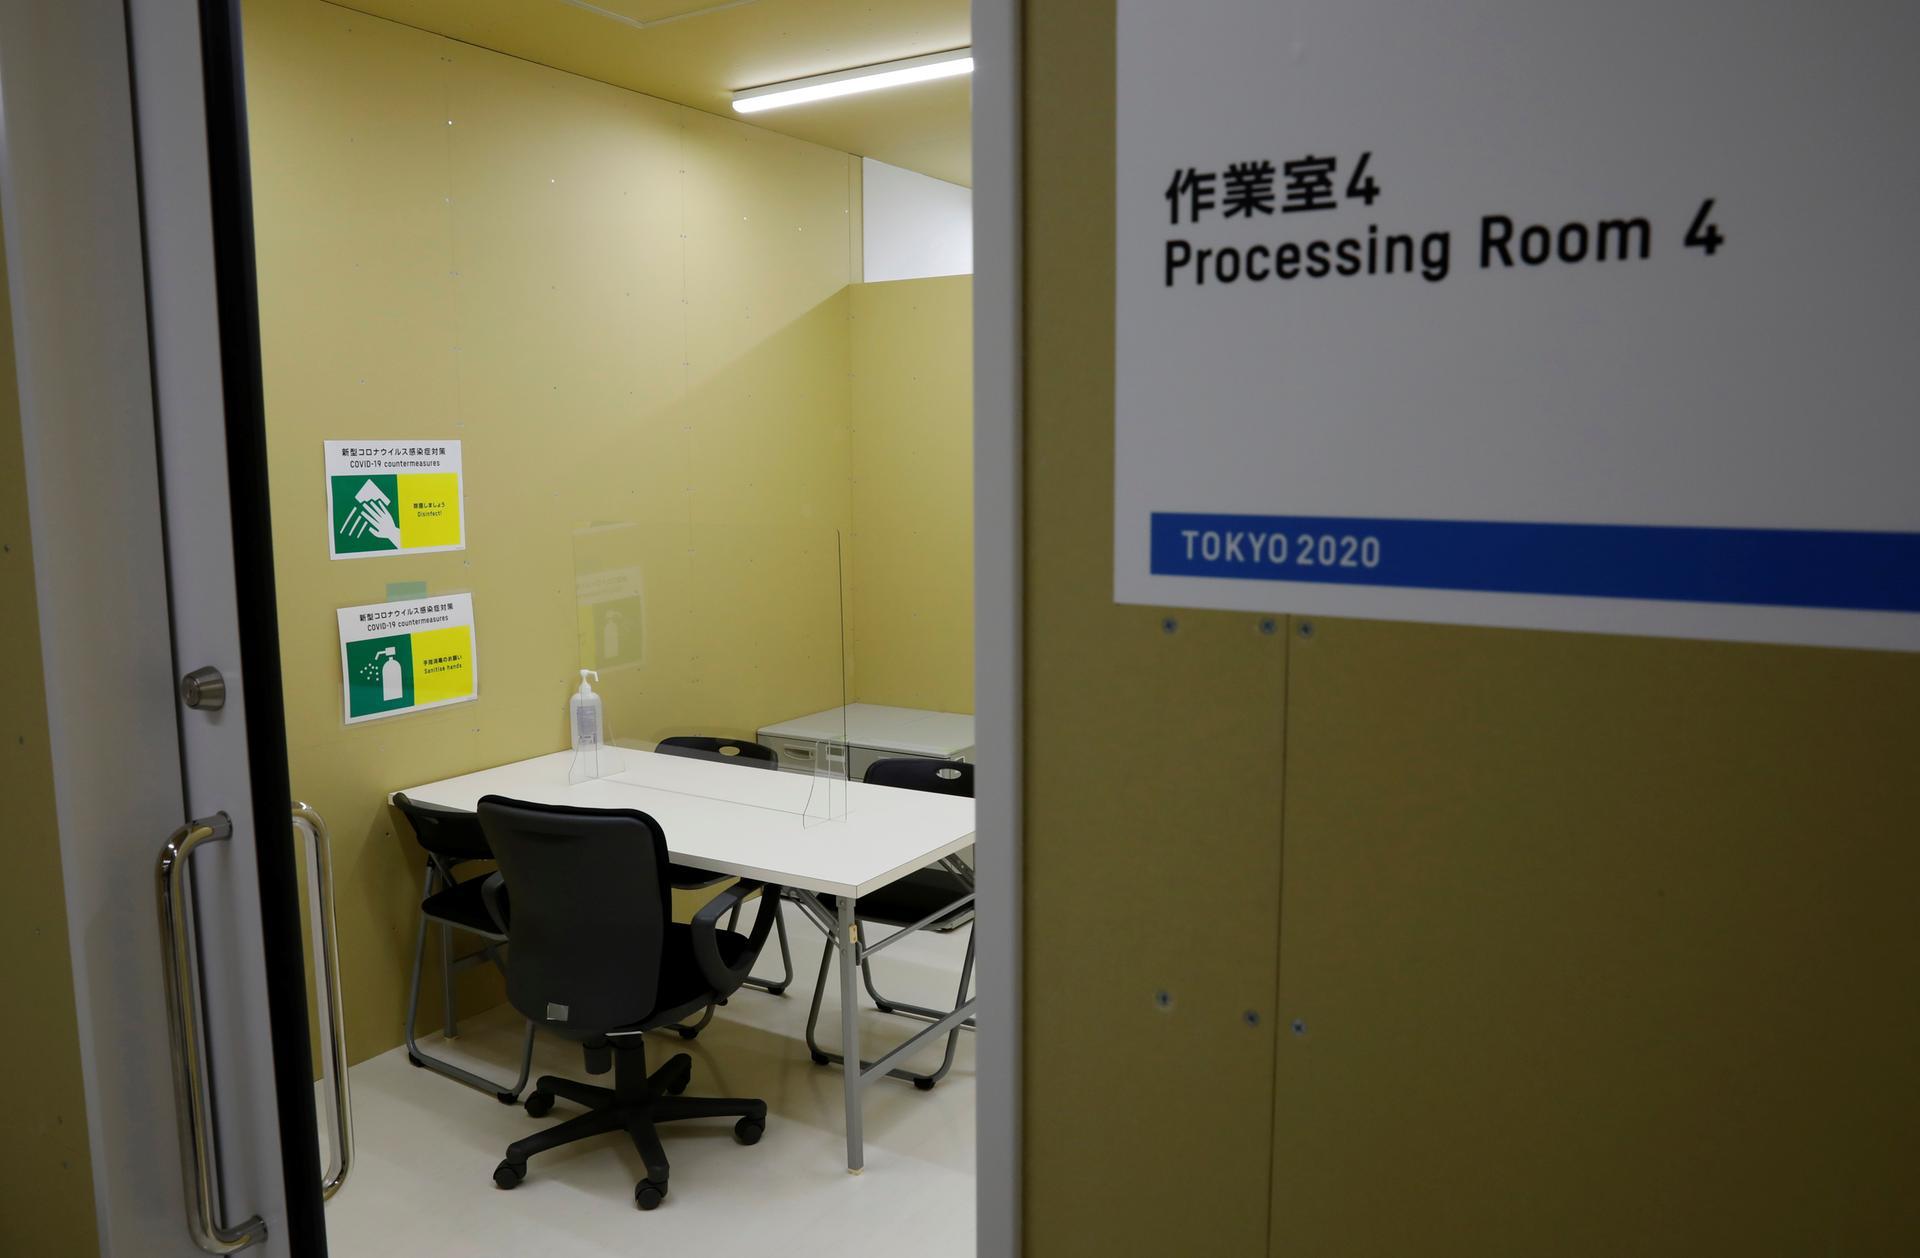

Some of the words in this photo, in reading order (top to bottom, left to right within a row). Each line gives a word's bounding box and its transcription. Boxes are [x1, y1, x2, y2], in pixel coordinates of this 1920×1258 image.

[1164, 152, 1382, 225] 作業室4
[1164, 225, 1451, 288] Processing
[1479, 214, 1652, 270] Room
[1683, 198, 1725, 257] 4
[341, 447, 446, 457] 新型コロナウイルス感染症対策
[350, 460, 382, 469] COVID-19
[384, 460, 440, 468] countermeasures
[1181, 529, 1289, 565] TOKYO
[1297, 535, 1381, 568] 2020
[359, 602, 455, 622] 新型コロナウイルス感染症対策
[367, 621, 396, 632] COVID-19
[397, 615, 449, 628] countermeasures
[447, 663, 462, 672] hands
